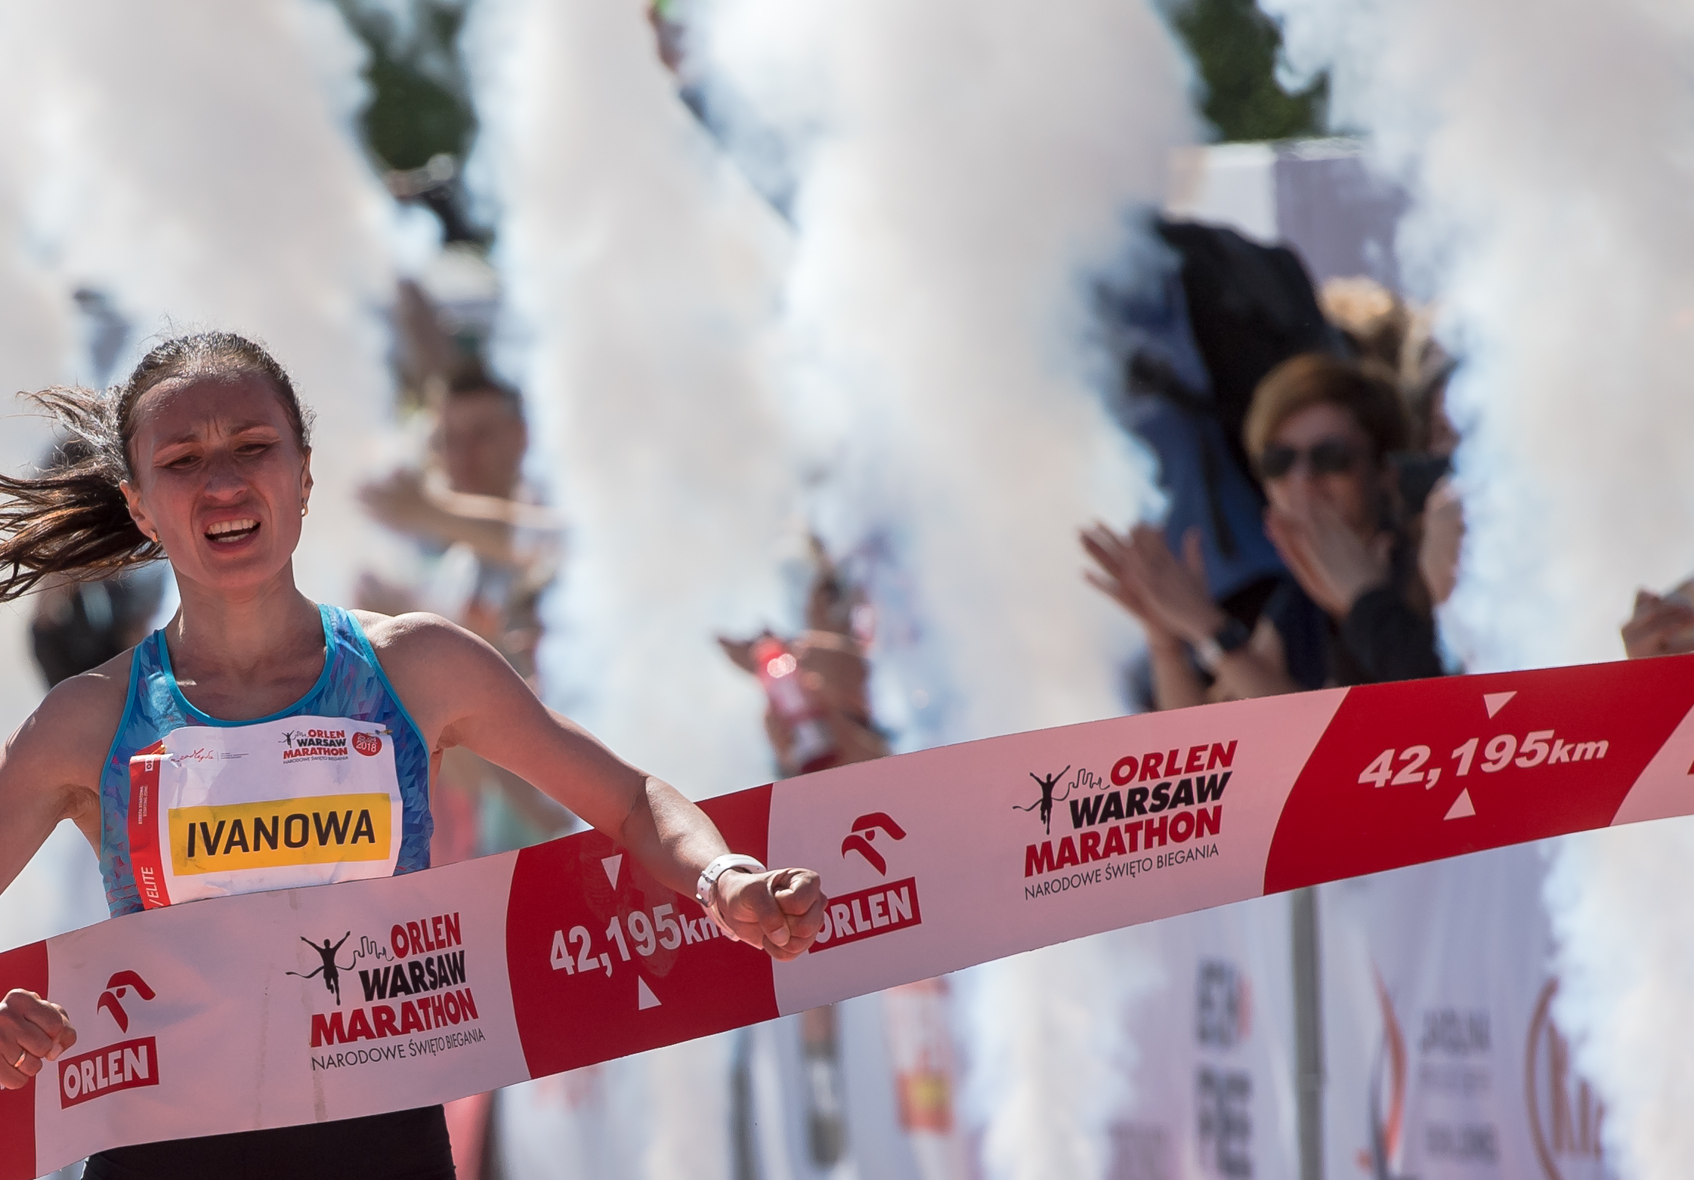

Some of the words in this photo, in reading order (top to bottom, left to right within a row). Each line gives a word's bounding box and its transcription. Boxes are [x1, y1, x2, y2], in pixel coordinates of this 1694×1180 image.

[283, 747, 348, 759] MARATHON
[296, 738, 347, 747] WARSAW
[308, 729, 345, 739] ORLEN
[356, 740, 377, 753] 2018
[1110, 740, 1238, 786] ORLEN
[1358, 729, 1609, 790] 42,195km
[1069, 771, 1233, 829] WARSAW
[187, 809, 376, 858] IVANOWA
[1024, 805, 1222, 878] MARATHON
[1024, 869, 1102, 900] NARODOWE
[1105, 858, 1153, 881] ŚWIĘTO
[1157, 843, 1219, 869] BIEGANIA
[391, 912, 462, 958] ORLEN
[359, 950, 466, 1002] WARSAW
[310, 988, 479, 1048] MARATHON
[63, 1045, 149, 1099] ORLEN
[311, 1044, 406, 1071] NARODOWE
[408, 1036, 445, 1057] ŚWIĘTO
[446, 1028, 486, 1050] BIEGANIA
